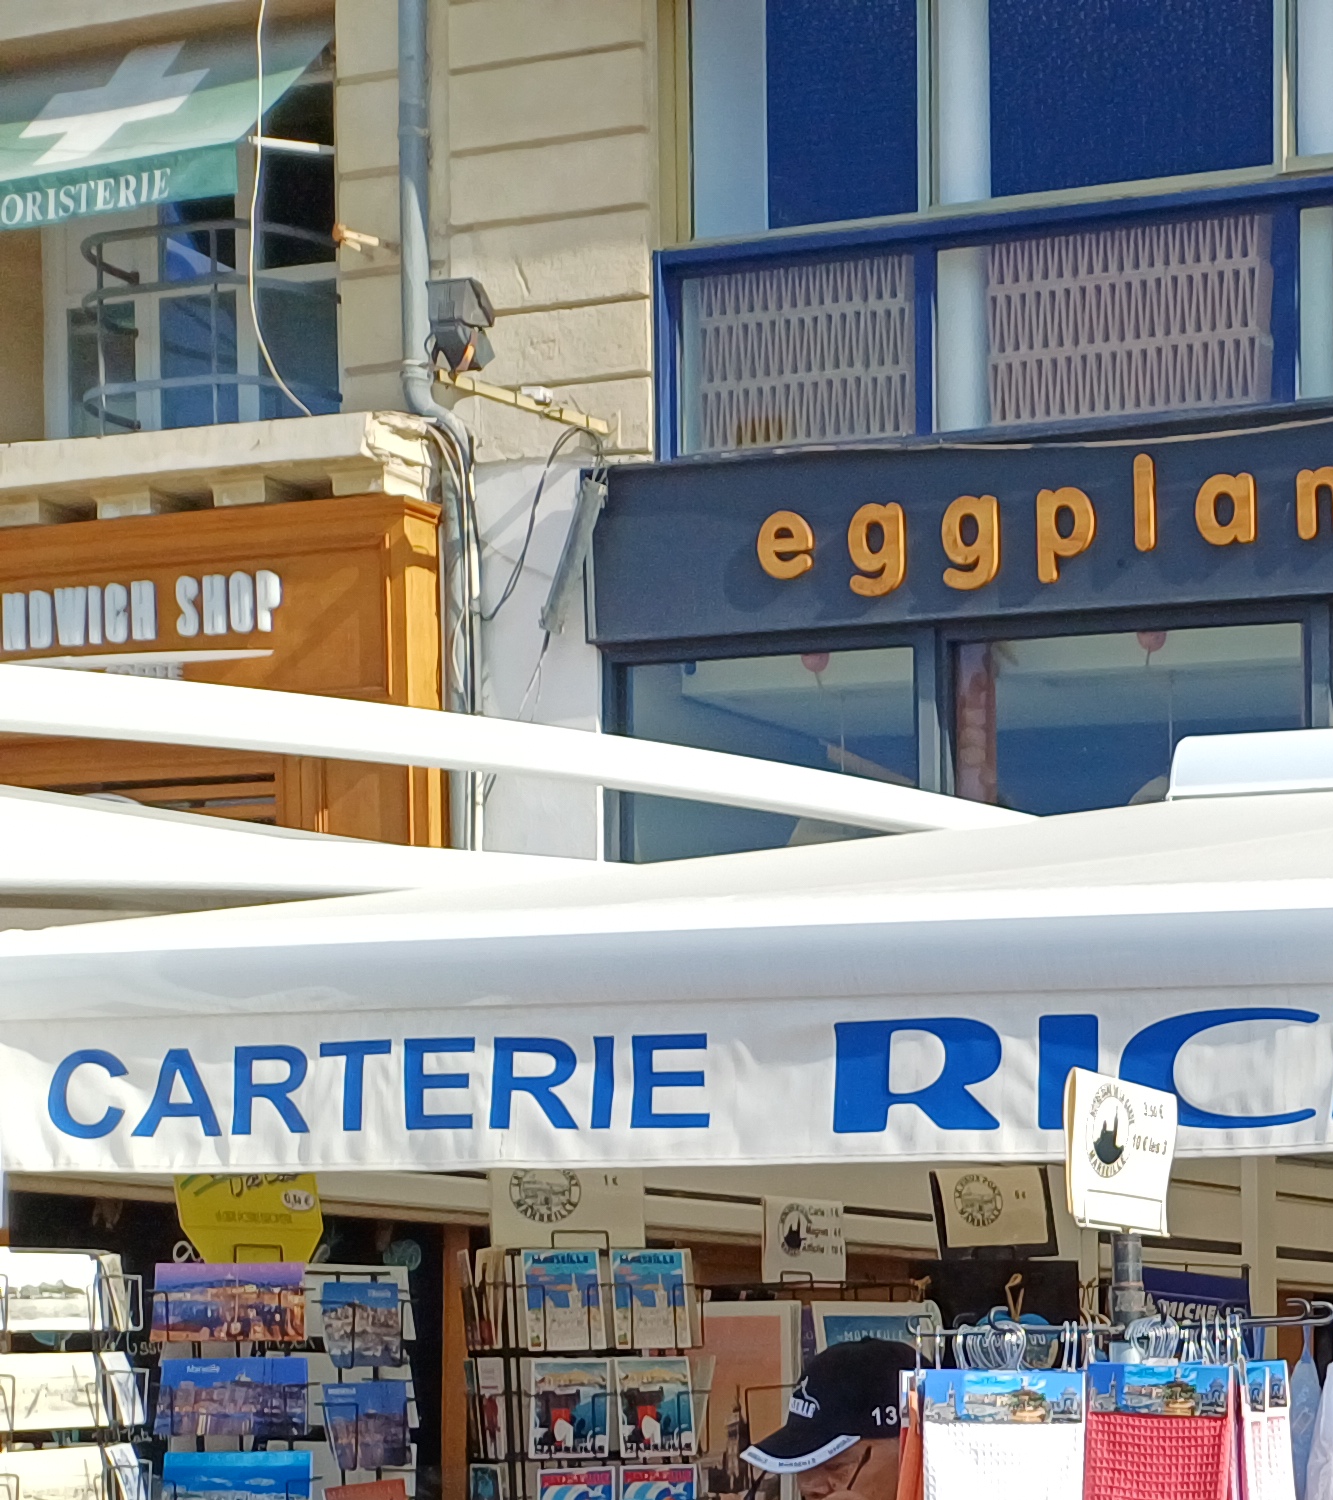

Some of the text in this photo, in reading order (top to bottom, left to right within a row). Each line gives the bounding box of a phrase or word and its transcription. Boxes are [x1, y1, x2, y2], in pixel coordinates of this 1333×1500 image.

[1, 168, 170, 225] ORISTERIE
[176, 570, 280, 637] SHOP
[48, 1032, 709, 1140] CARTERIE
[871, 1405, 898, 1426] 13
